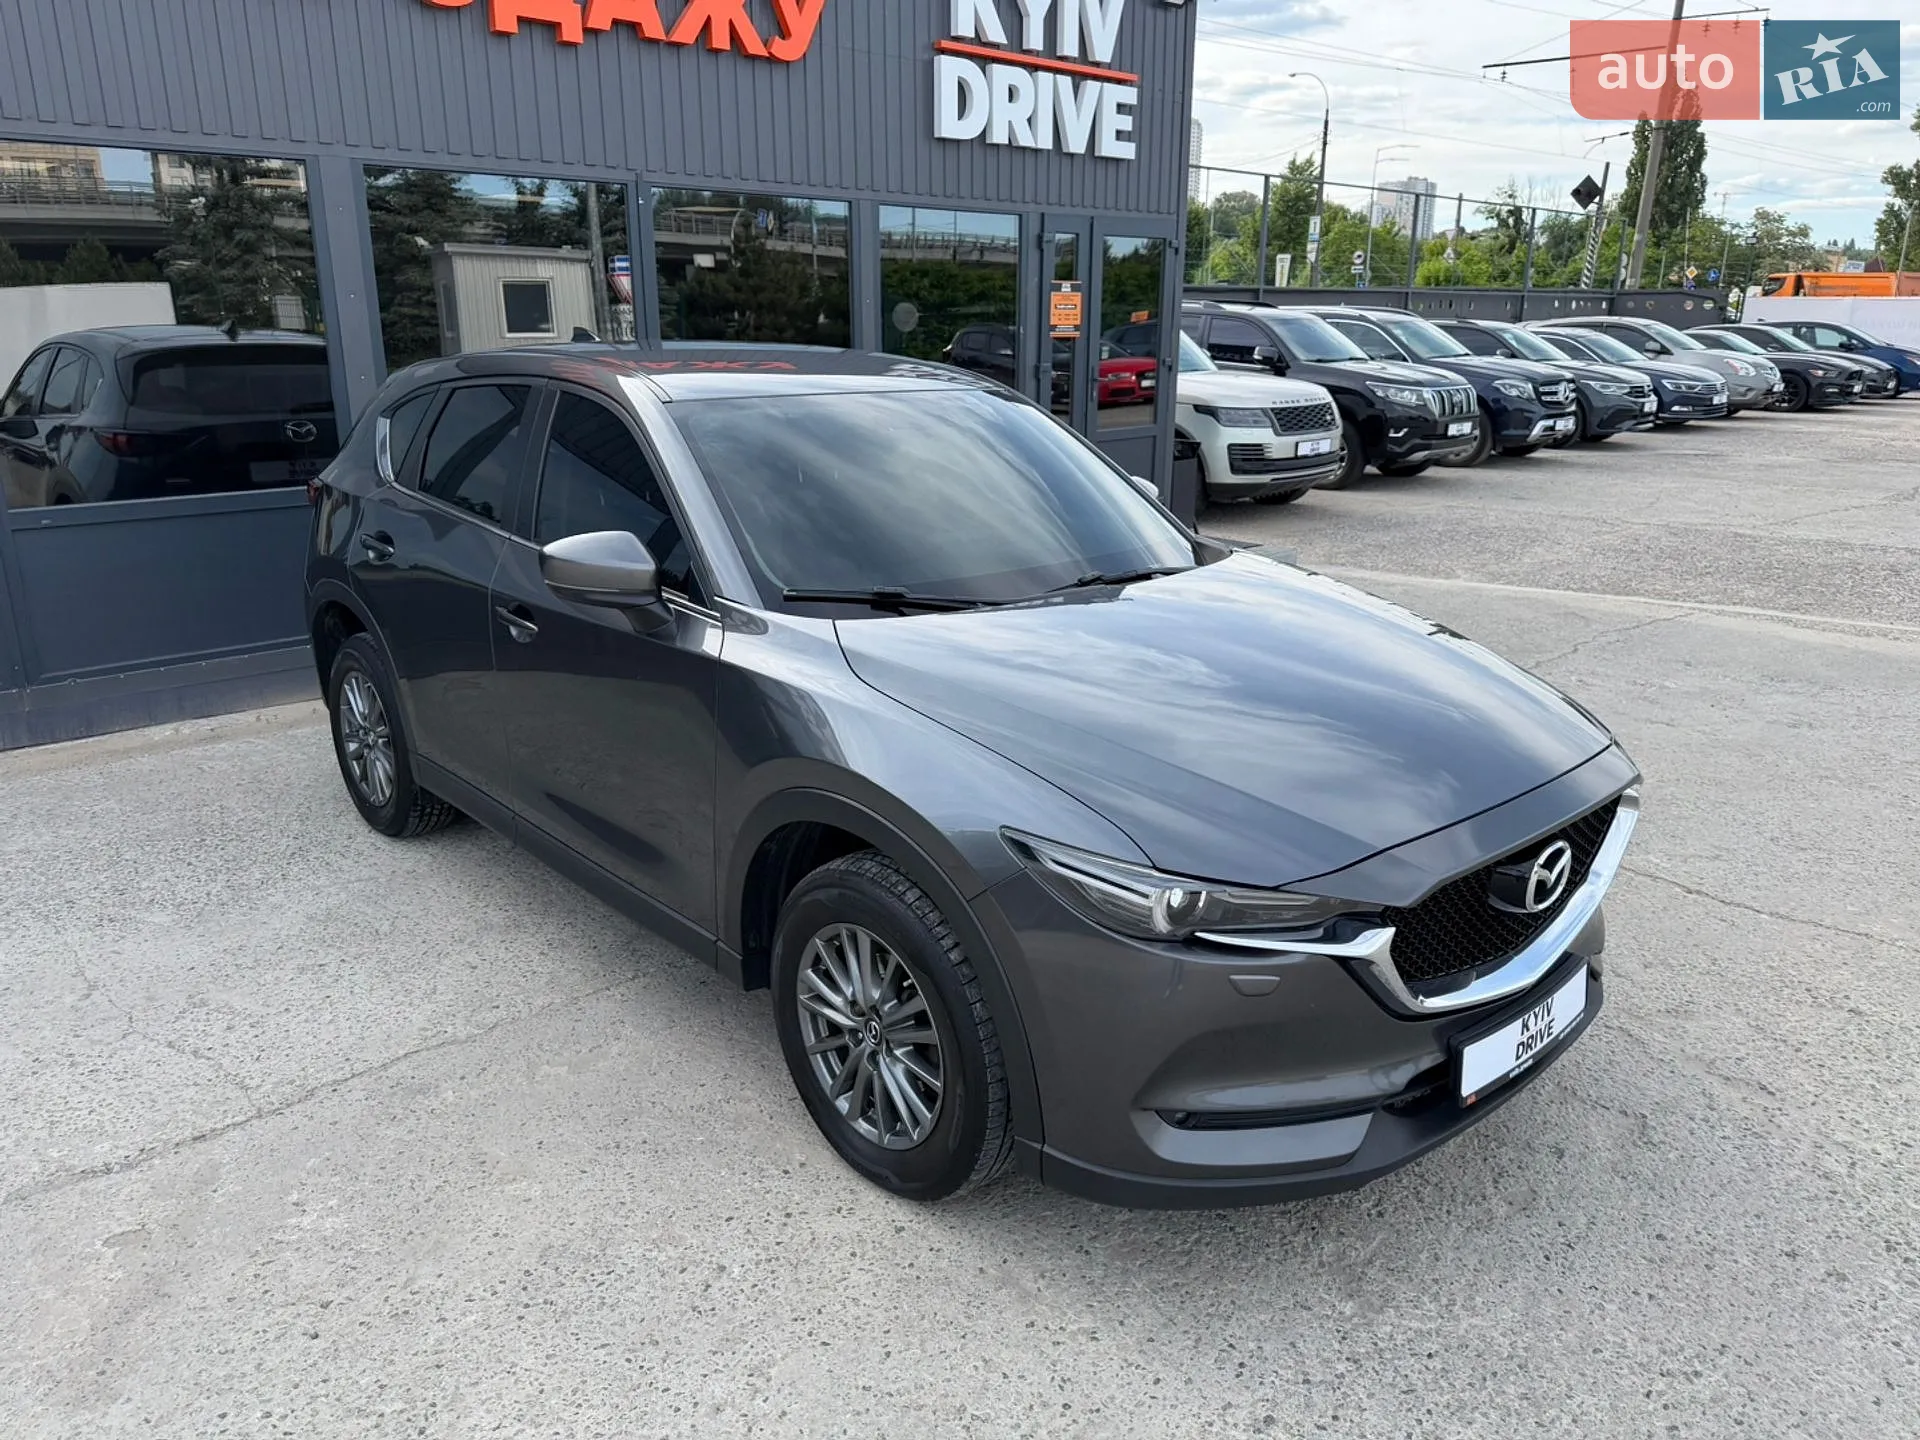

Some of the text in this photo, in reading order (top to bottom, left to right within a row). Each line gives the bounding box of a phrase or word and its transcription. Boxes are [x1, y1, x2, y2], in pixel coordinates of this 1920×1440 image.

[934, 54, 1138, 160] DRIVE
[1520, 995, 1555, 1037] KYIV
[1514, 1017, 1556, 1062] DRIVE
